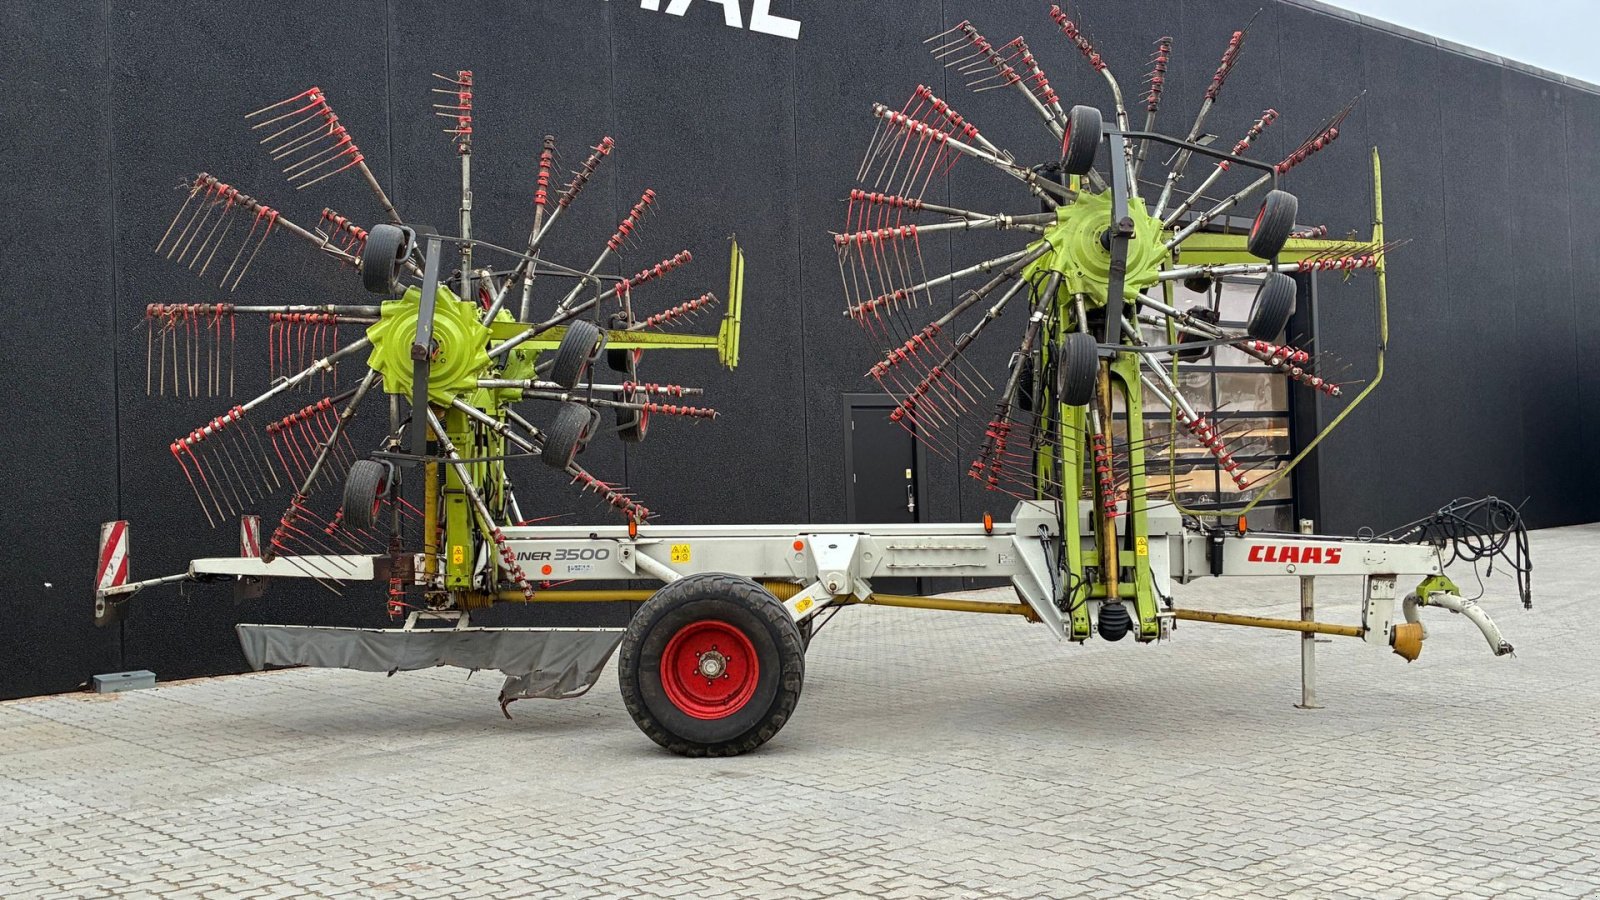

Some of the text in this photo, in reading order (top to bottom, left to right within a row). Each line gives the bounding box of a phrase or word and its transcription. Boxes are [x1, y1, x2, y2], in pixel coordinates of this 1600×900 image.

[515, 549, 609, 561] INER 3500
[1248, 546, 1342, 564] CLAAS
